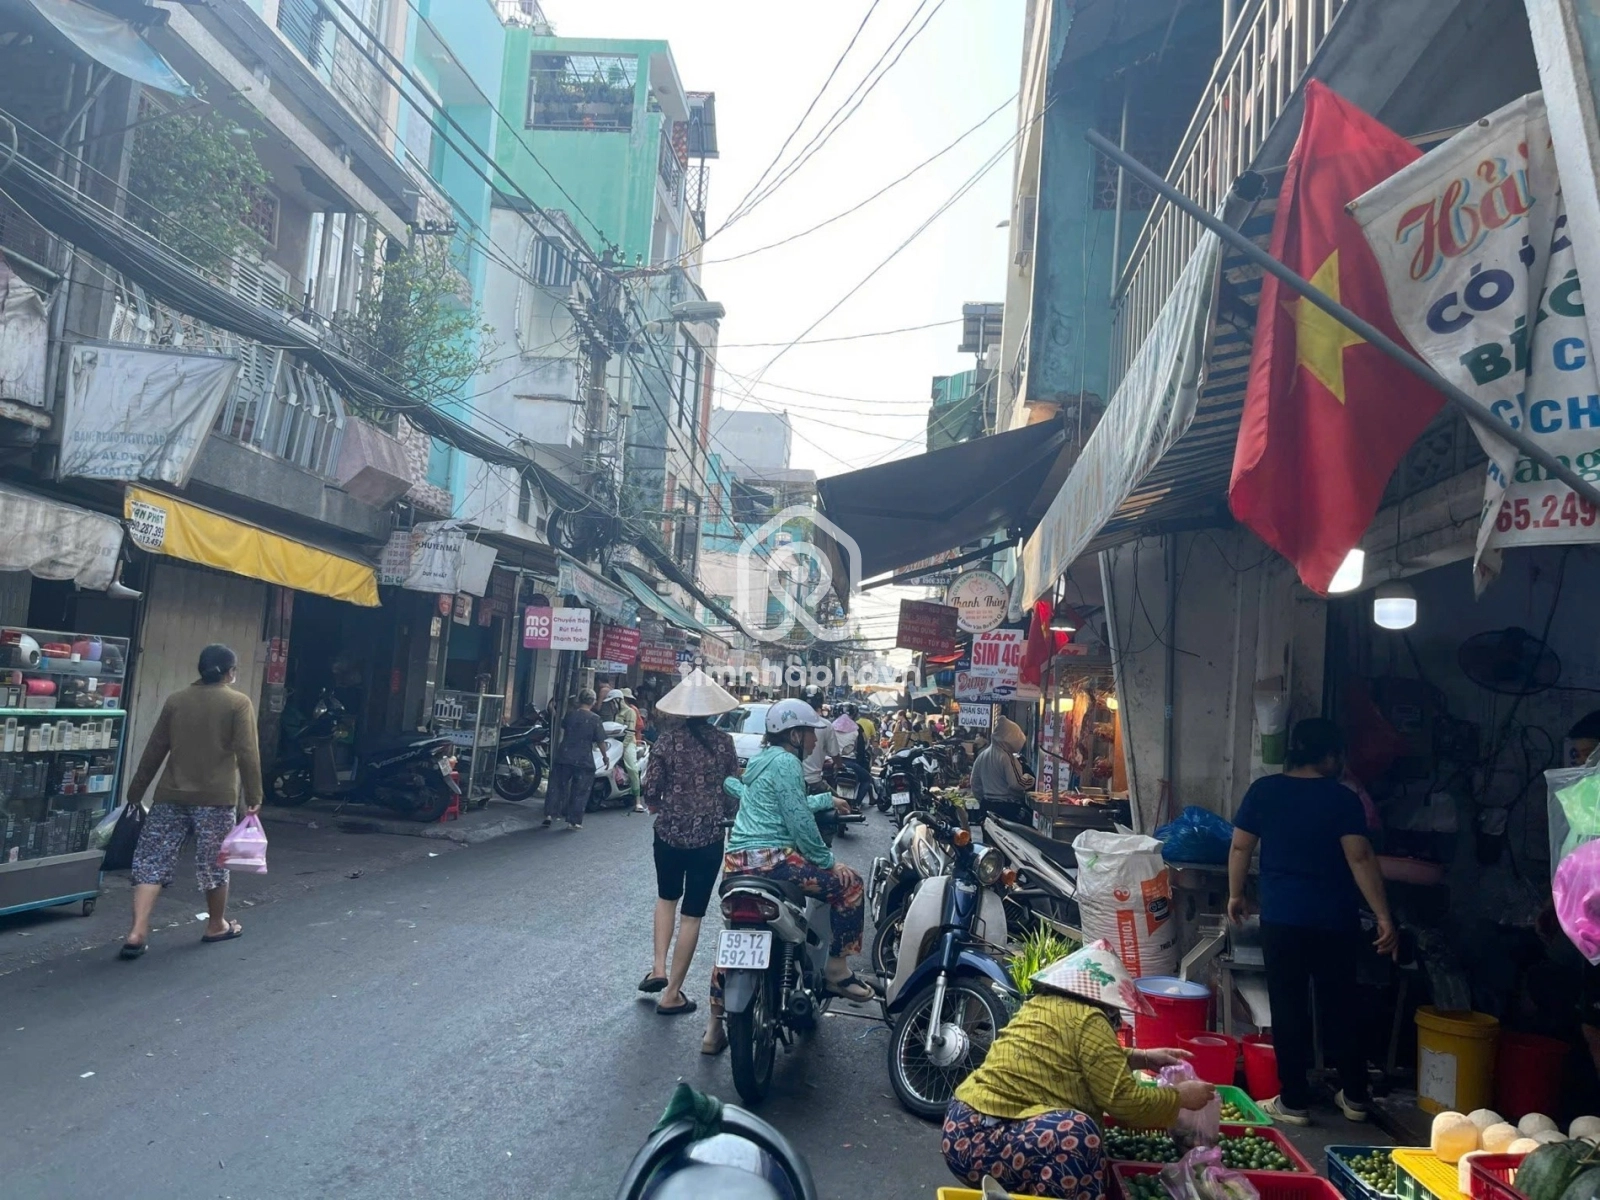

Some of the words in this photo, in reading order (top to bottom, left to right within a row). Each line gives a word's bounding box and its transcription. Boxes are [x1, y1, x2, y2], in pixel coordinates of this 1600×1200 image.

[1426, 262, 1515, 334] CÓ
[951, 596, 981, 609] Thanh
[980, 631, 1017, 642] BÁN
[973, 642, 1000, 666] SIM
[1001, 643, 1020, 668] 4G
[720, 949, 766, 967] 592.14
